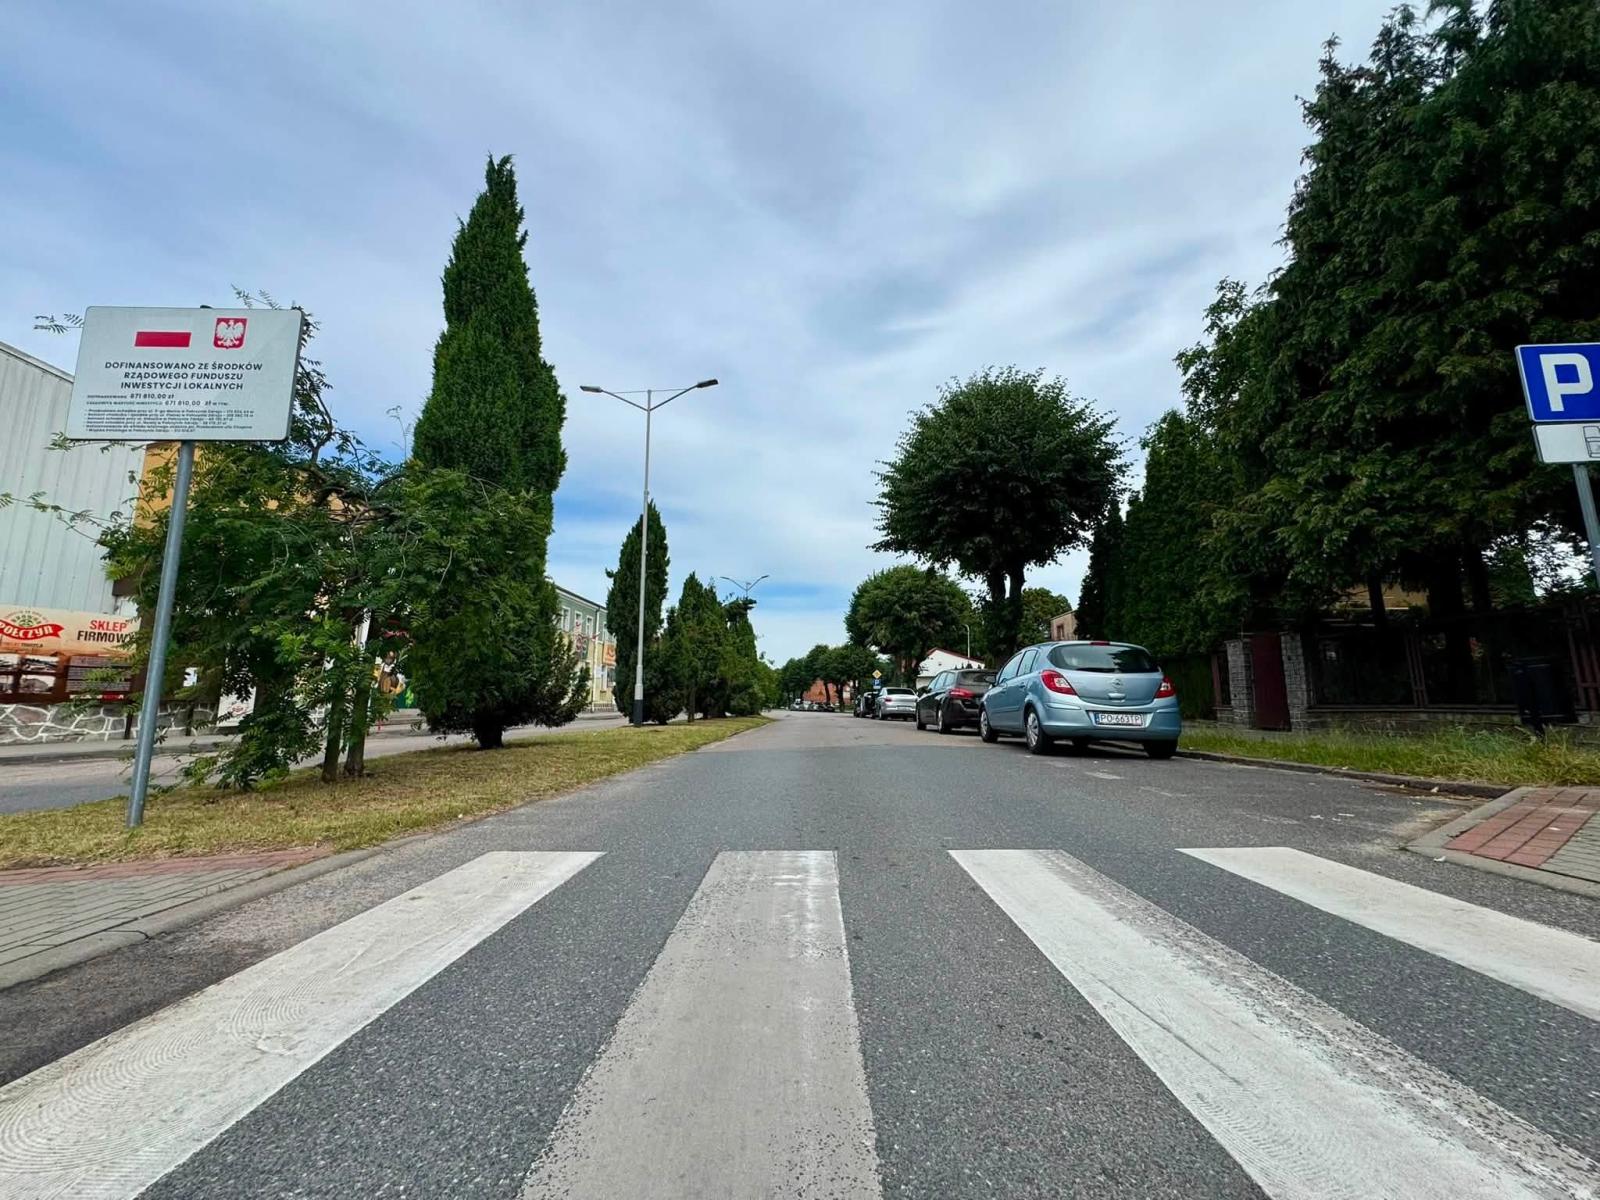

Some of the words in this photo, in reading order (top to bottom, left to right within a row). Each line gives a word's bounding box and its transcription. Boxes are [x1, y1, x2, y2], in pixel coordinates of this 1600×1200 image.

[104, 361, 196, 370] DOFINANSOWANO
[198, 362, 209, 370] ZE
[211, 361, 263, 371] ŚRODKÓW
[123, 372, 189, 381] RZĄDOWEGO
[120, 382, 182, 390] INWESTYCJI
[184, 382, 244, 390] LOKALNYCH
[1539, 353, 1594, 412] P
[89, 619, 128, 632] SKLEP
[1100, 714, 1113, 722] PO
